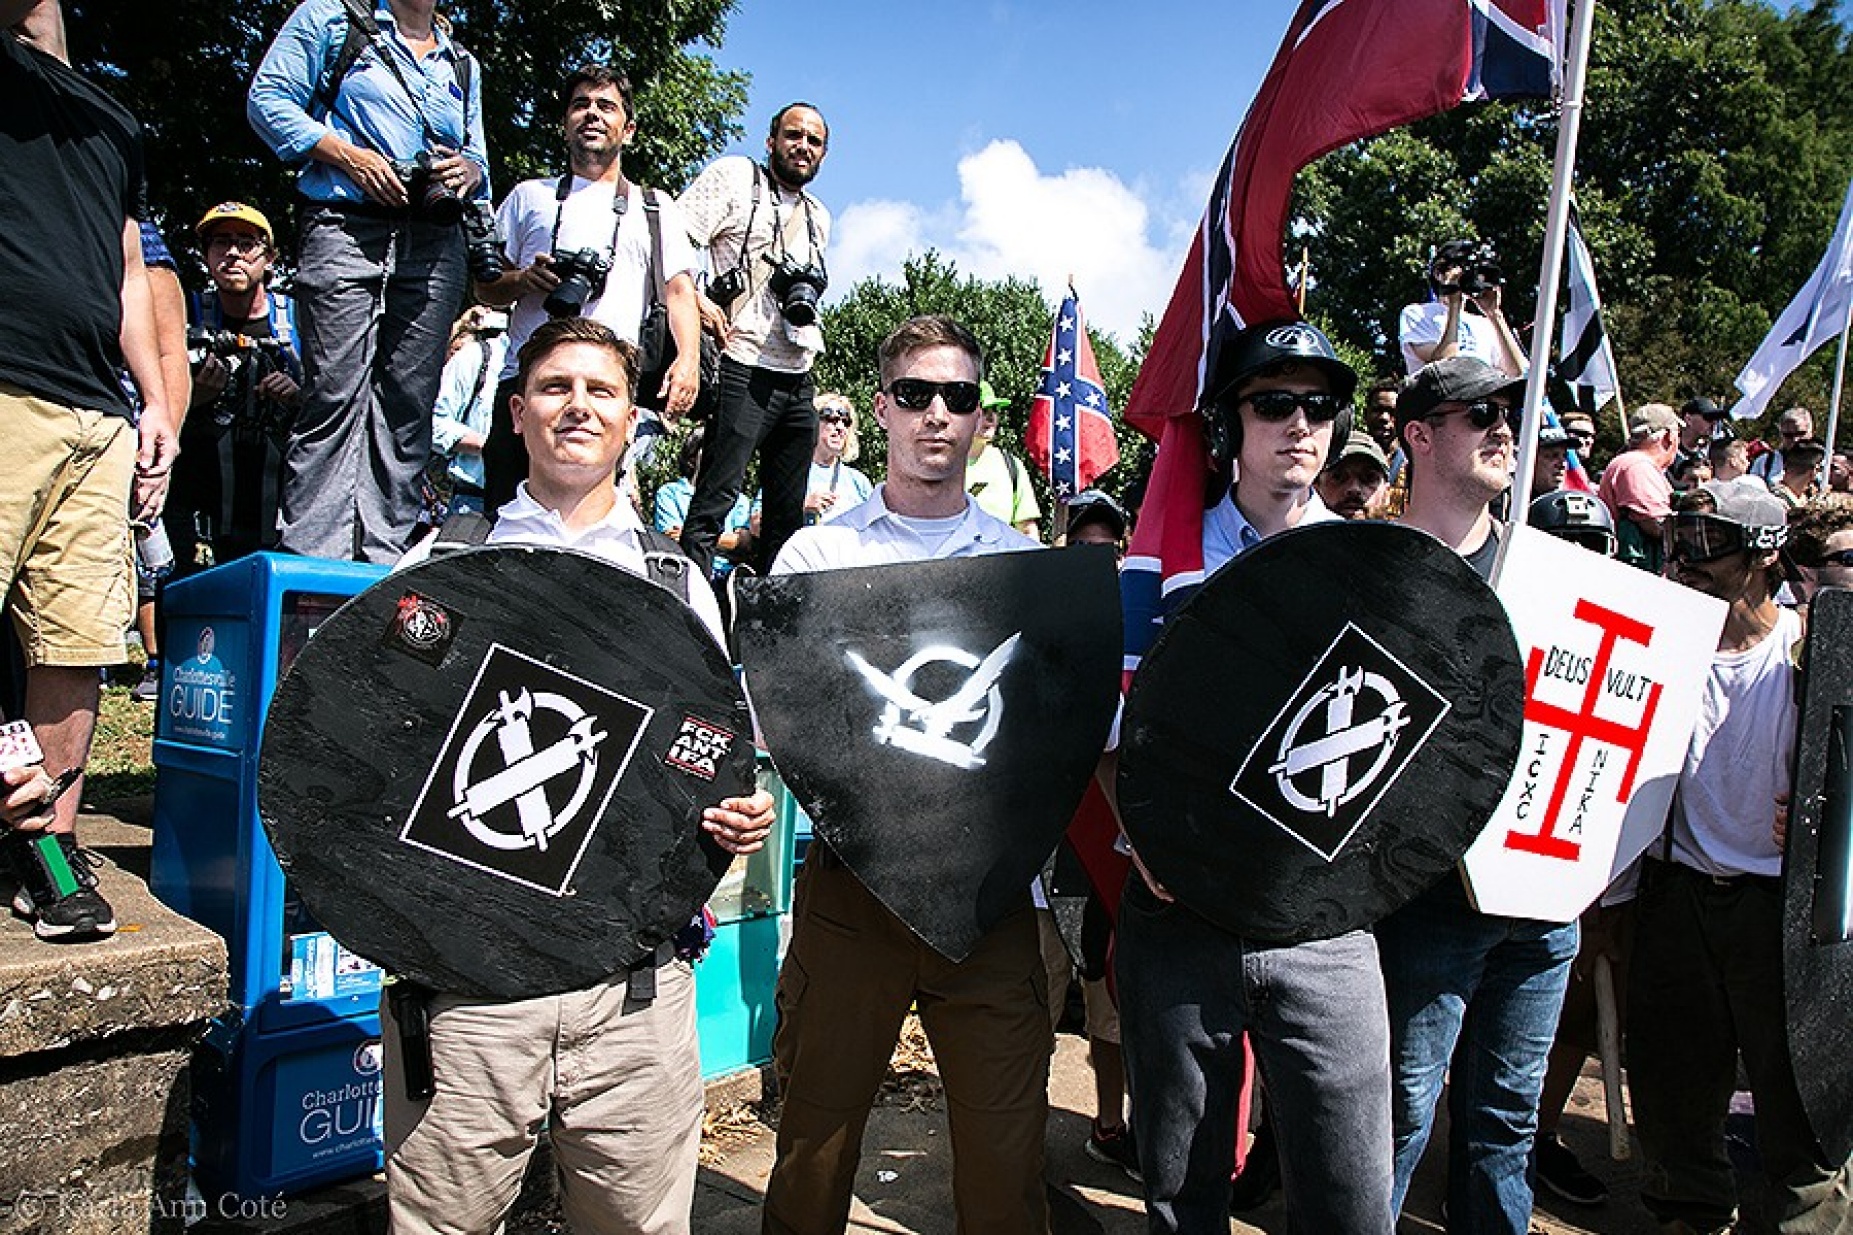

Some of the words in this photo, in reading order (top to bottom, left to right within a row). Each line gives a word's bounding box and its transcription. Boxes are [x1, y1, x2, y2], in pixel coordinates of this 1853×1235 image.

[1543, 645, 1593, 685] DEUS
[1606, 667, 1652, 702] VULT
[170, 684, 236, 725] GUIDE
[674, 736, 732, 760] ANT
[680, 721, 731, 749] FCK
[668, 744, 716, 774] IFA
